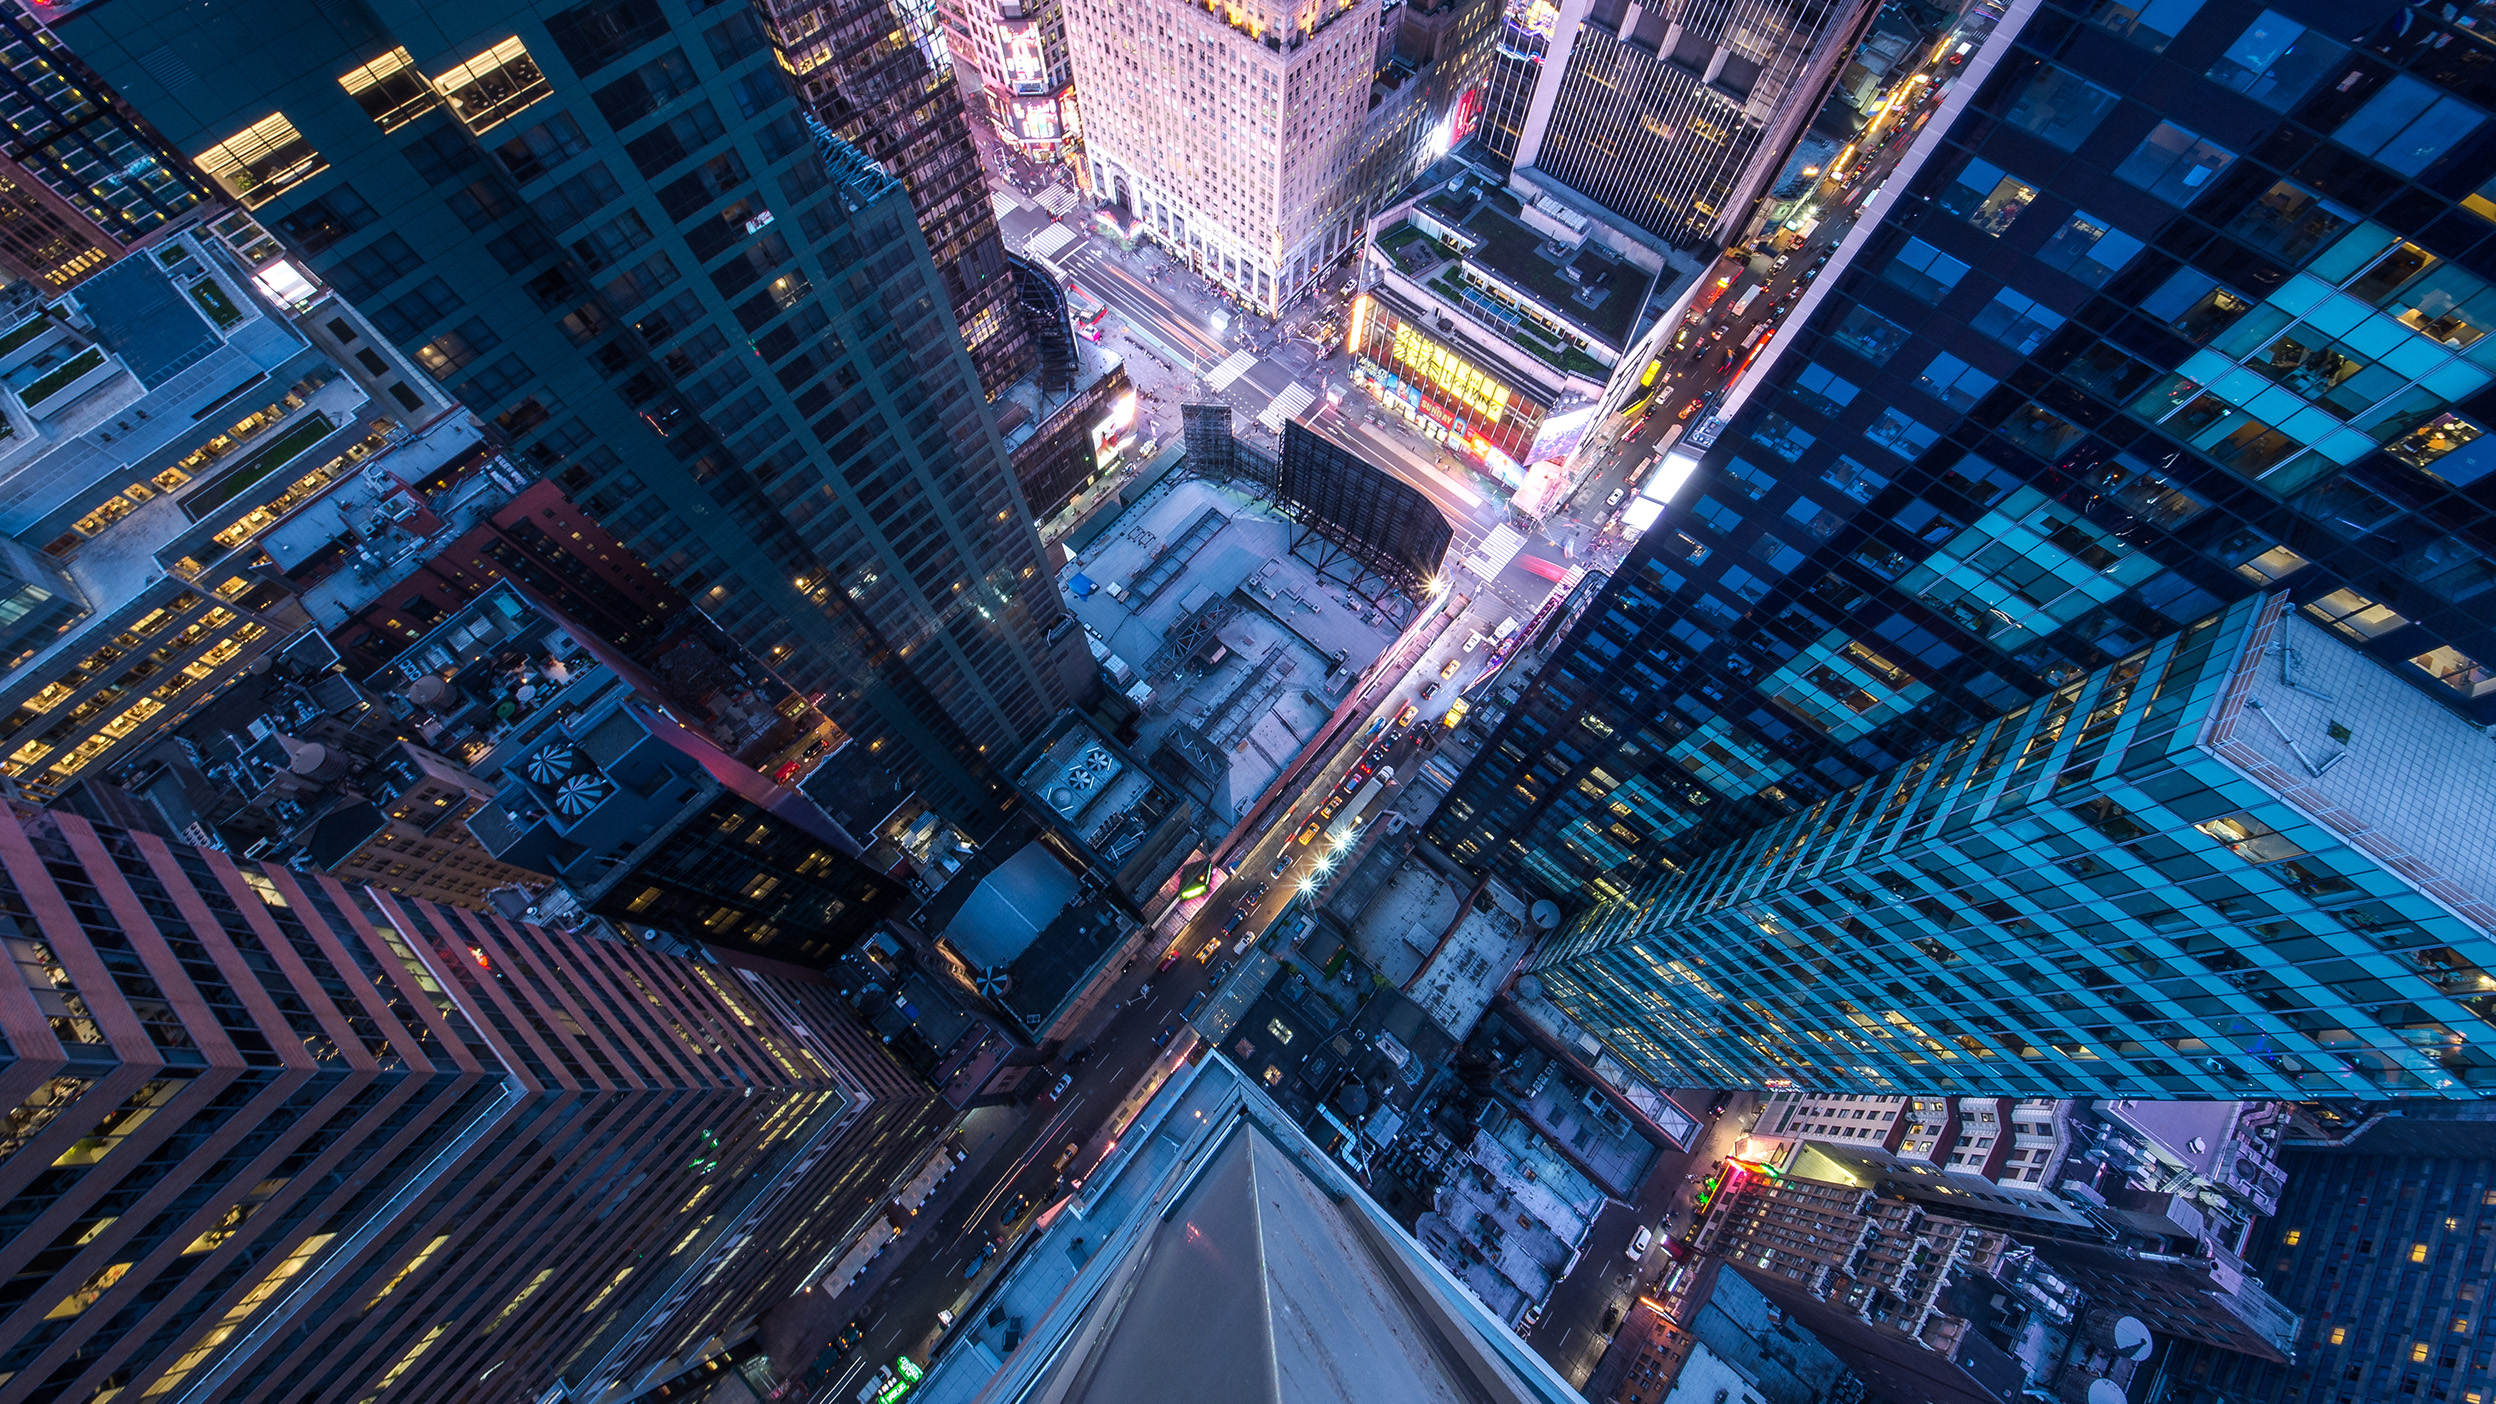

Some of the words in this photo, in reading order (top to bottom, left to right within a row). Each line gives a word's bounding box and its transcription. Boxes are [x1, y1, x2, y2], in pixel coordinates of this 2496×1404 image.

[1444, 370, 1470, 393] LION
[1470, 387, 1498, 412] KING
[1464, 372, 1480, 386] THE
[1420, 399, 1453, 425] SUNDAY
